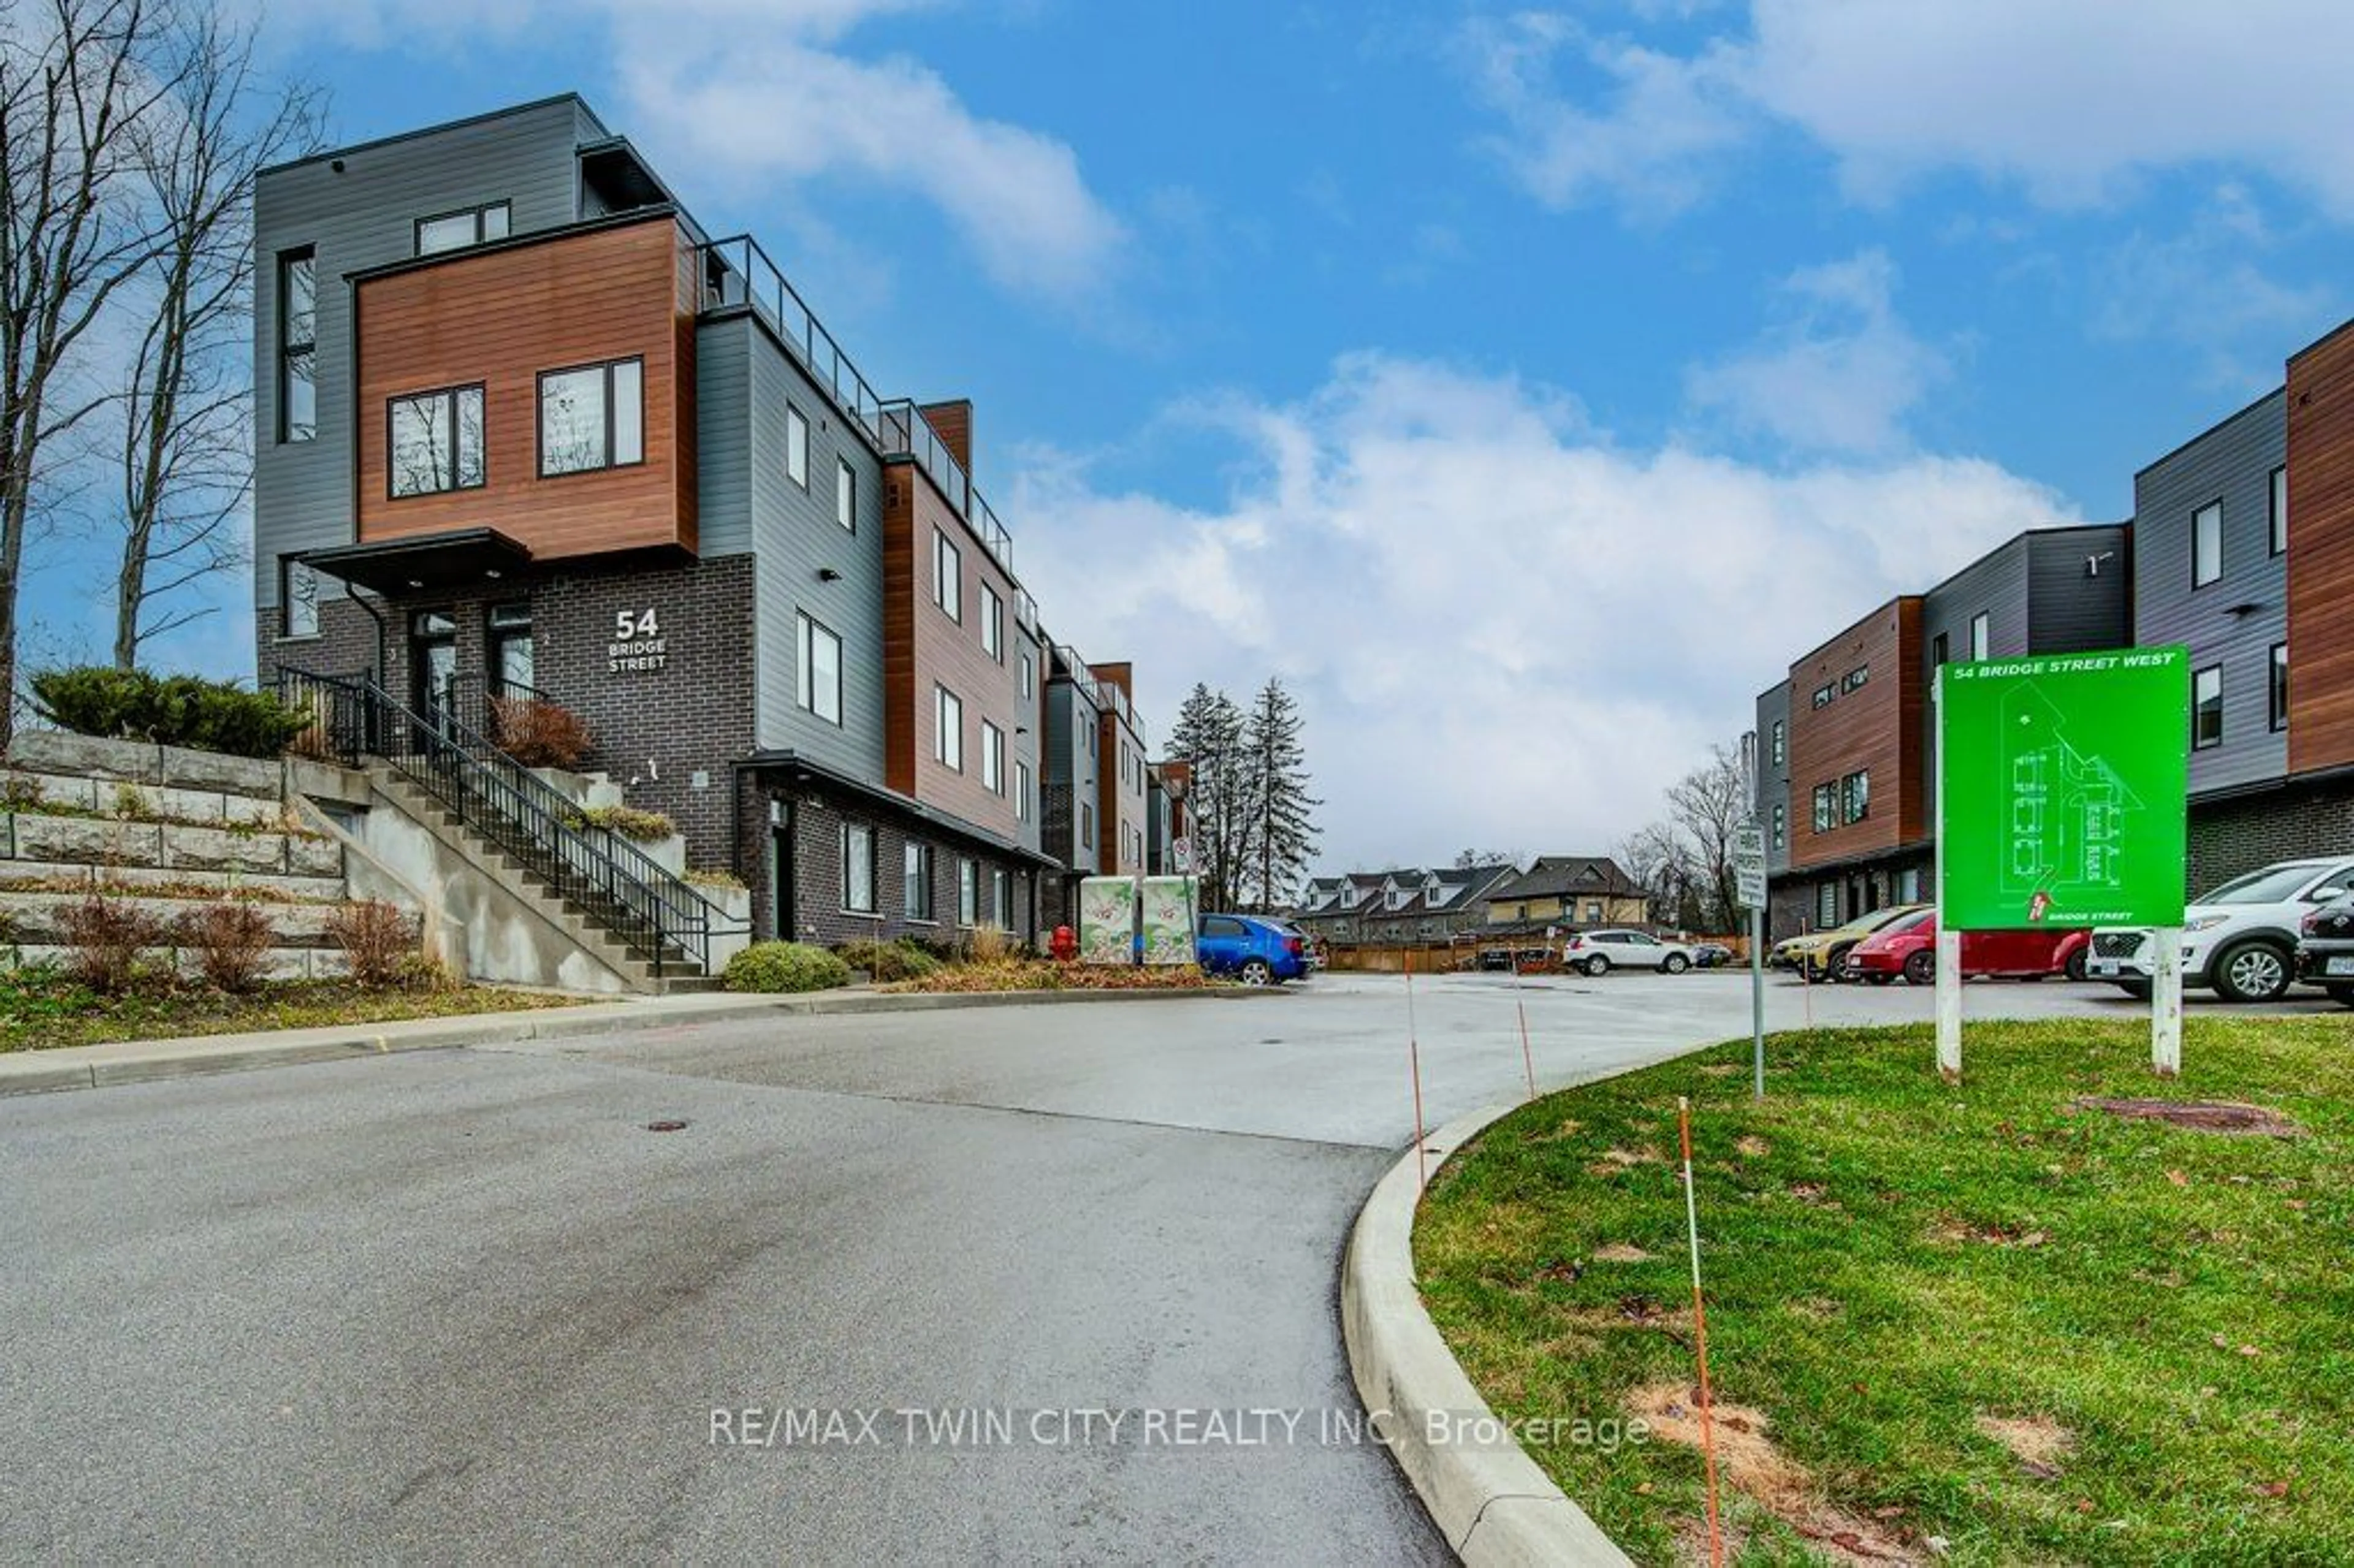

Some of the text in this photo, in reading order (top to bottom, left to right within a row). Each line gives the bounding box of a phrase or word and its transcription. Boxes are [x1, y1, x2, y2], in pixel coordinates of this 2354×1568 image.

[615, 608, 659, 640] 54
[609, 640, 666, 656] BRIDGE
[609, 655, 666, 672] STREET
[1954, 652, 2176, 679] 54 BRIDGE STREET WEST
[2091, 912, 2134, 921] STREET
